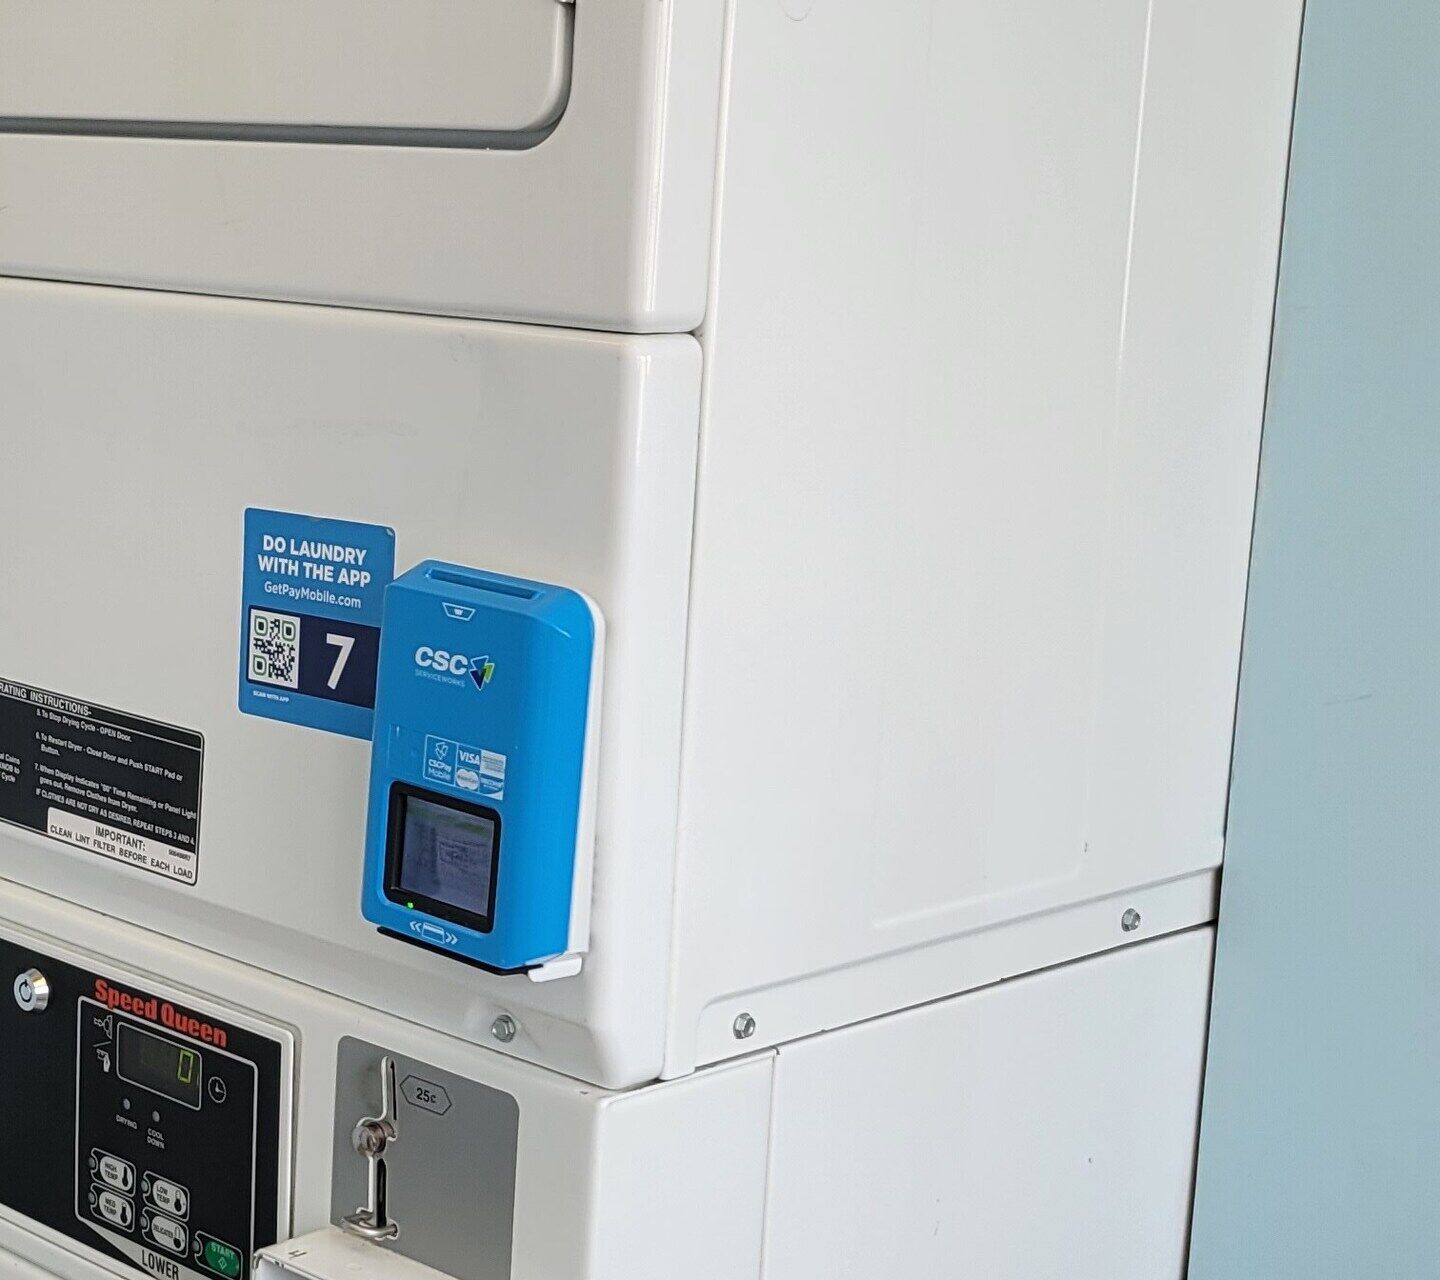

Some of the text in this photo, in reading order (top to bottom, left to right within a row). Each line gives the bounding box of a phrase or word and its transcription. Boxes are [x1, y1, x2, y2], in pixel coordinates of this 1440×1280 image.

[263, 535, 367, 566] DO LAUNDRY
[258, 554, 371, 588] WITH THE APP
[264, 581, 361, 609] GetPayMobile.com
[326, 633, 355, 690] 7
[415, 646, 468, 675] CSC
[459, 750, 480, 765] VISA
[50, 824, 192, 879] CLEAN LINT FILTER BEFORE EACH LOAD
[95, 825, 146, 851] IMPORTANT:
[95, 979, 227, 1048] Speed Queen
[177, 1048, 194, 1084] 0
[148, 1128, 164, 1140] COOL
[105, 1170, 118, 1180] TEMP
[157, 1186, 168, 1195] LOW
[157, 1194, 170, 1204] TEMP
[211, 1243, 235, 1258] START
